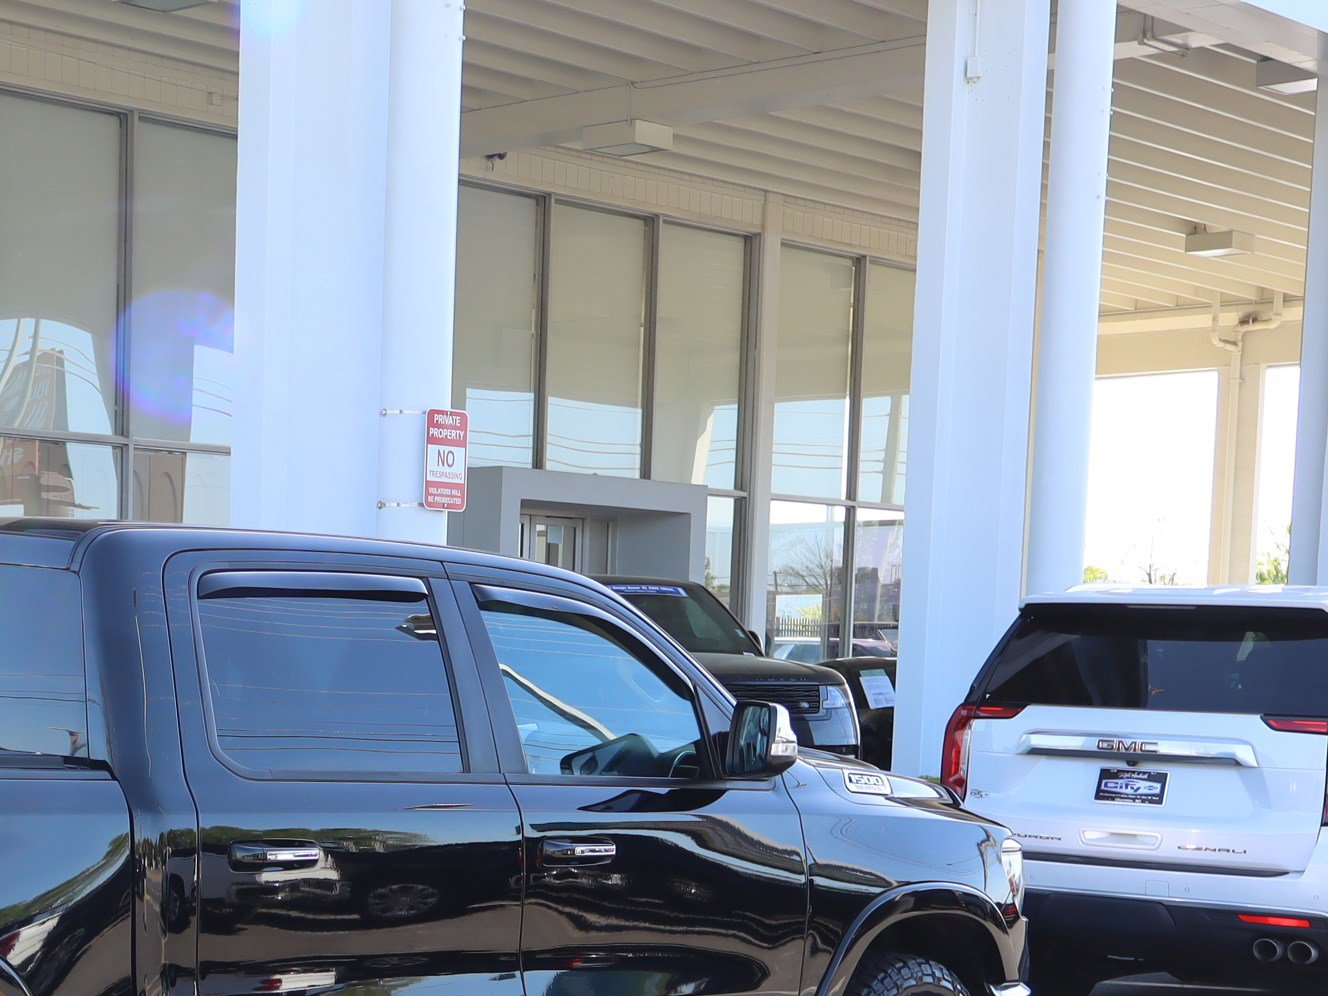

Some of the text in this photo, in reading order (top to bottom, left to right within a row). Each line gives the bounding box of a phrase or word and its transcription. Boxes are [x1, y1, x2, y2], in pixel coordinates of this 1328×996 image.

[433, 413, 461, 426] PRIVATE
[429, 427, 464, 440] PROPERTY
[437, 449, 455, 468] NO
[429, 470, 463, 480] TRESPASSING
[428, 487, 462, 497] VIOLATORS WILL
[434, 496, 462, 505] PROSECUTED
[1097, 739, 1159, 754] GMC
[848, 773, 884, 786] 1500
